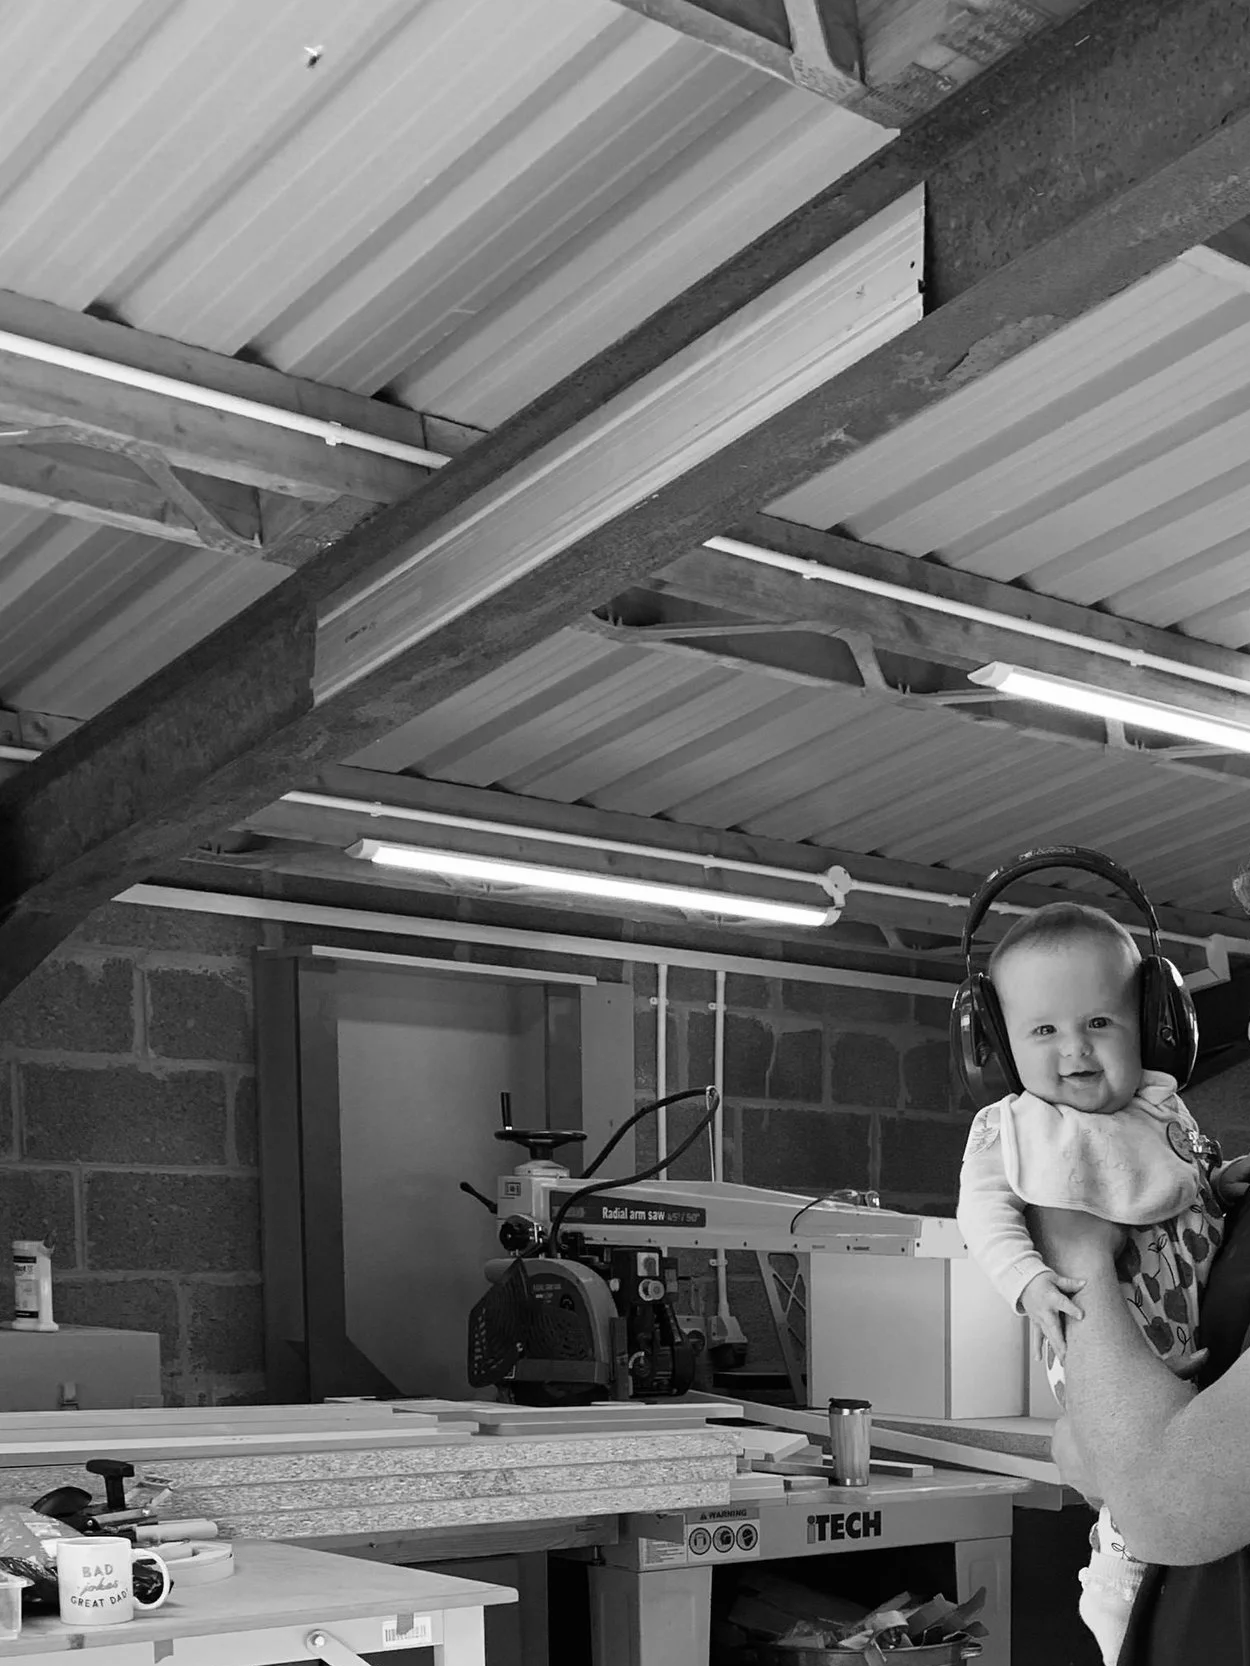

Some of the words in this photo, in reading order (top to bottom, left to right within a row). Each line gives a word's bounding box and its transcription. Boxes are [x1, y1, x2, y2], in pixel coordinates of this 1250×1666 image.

[602, 1206, 628, 1220] Radial
[629, 1210, 646, 1221] arm
[647, 1211, 665, 1221] saw
[708, 1508, 747, 1519] WARNING
[806, 1511, 882, 1544] iTECH
[82, 1564, 113, 1578] BAD
[80, 1577, 118, 1597] jokes
[71, 1595, 104, 1608] GREAT
